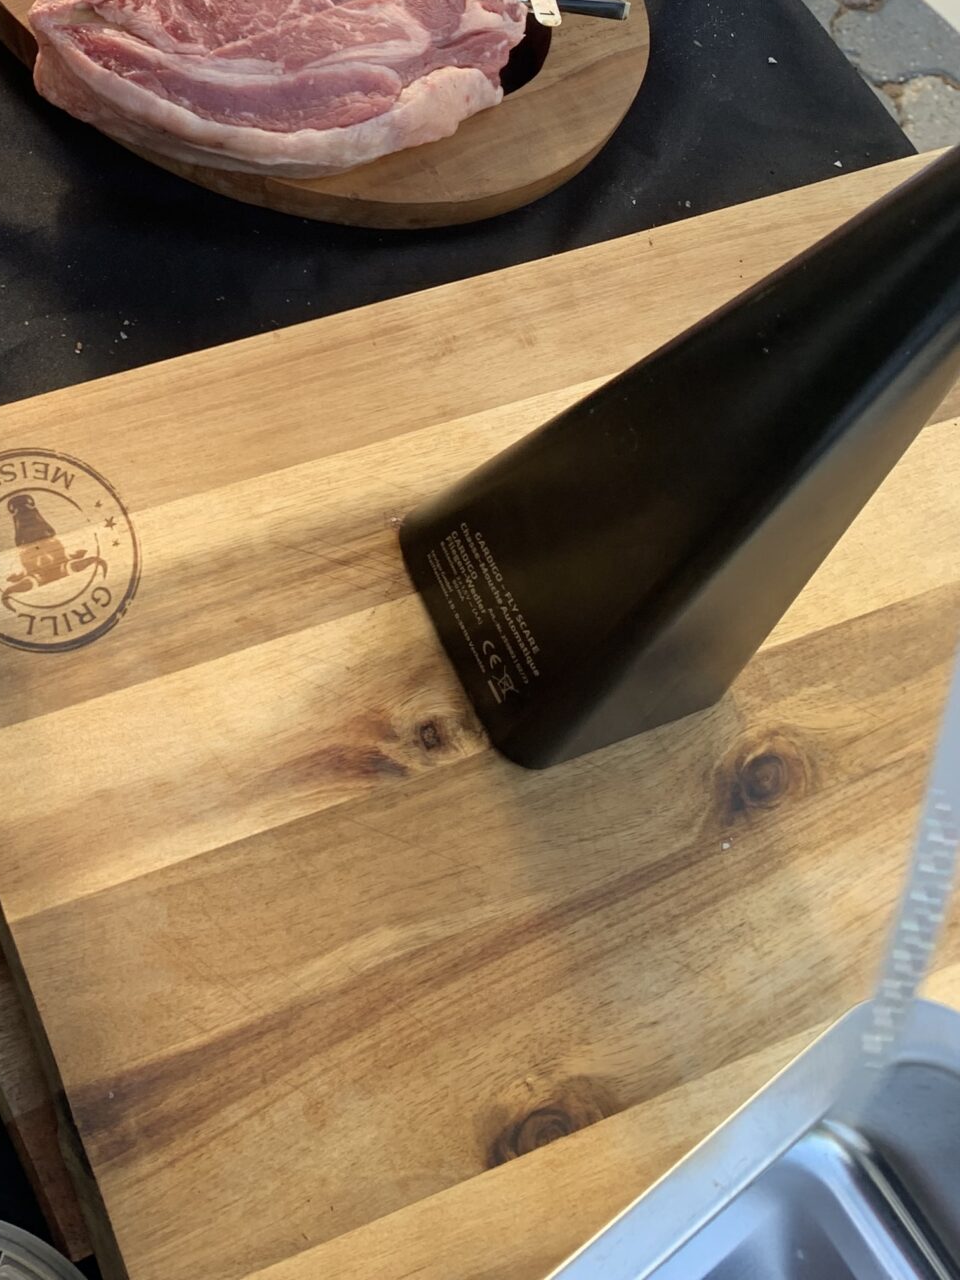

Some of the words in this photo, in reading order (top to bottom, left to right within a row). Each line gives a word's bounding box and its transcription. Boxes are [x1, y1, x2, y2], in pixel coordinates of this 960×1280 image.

[445, 535, 487, 614] Fliegen-Wedler
[450, 530, 479, 580] CARDIGO
[17, 586, 112, 636] GRILL
[472, 530, 505, 584] CARDIGO
[502, 590, 519, 614] FLY
[513, 613, 540, 655] SCARE
[499, 604, 540, 677] Automatique
